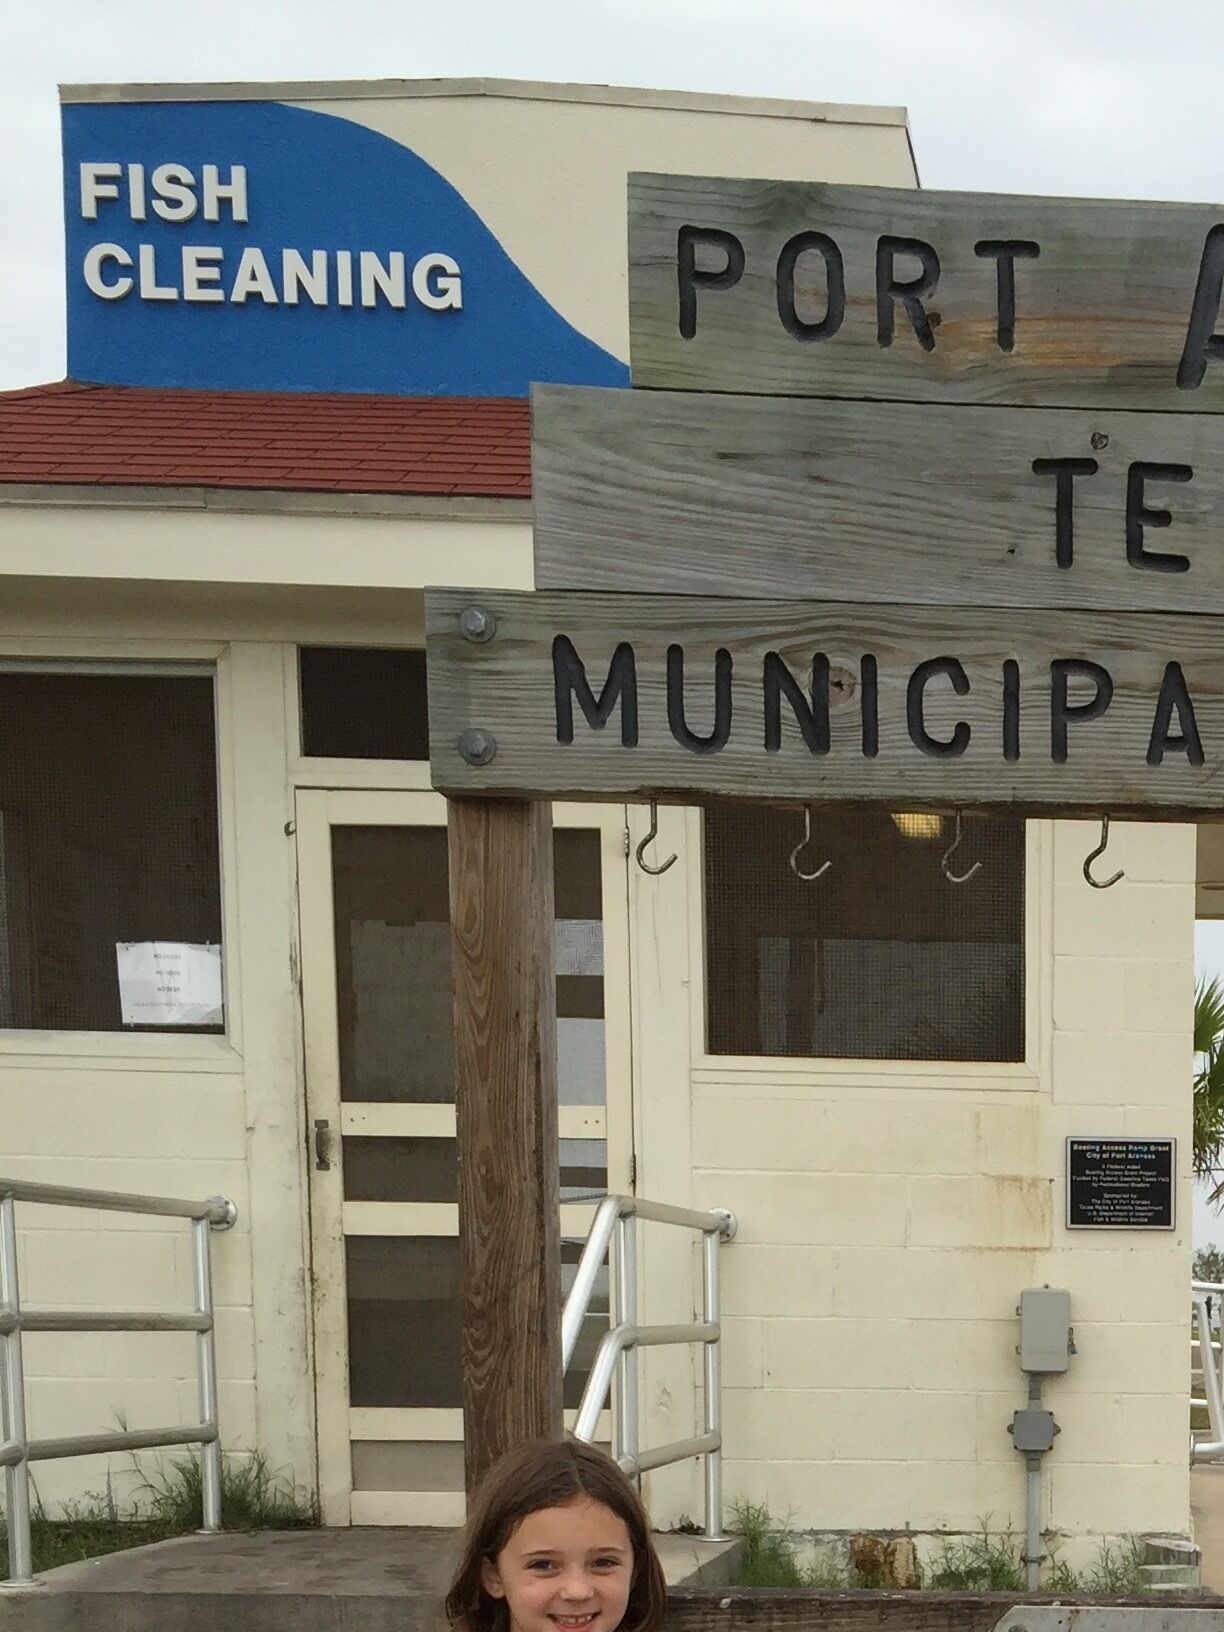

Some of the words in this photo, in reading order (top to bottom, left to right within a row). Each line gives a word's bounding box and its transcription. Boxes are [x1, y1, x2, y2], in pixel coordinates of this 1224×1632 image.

[80, 162, 249, 224] FISH
[82, 242, 464, 312] CLEANING
[677, 224, 1040, 352] PORT
